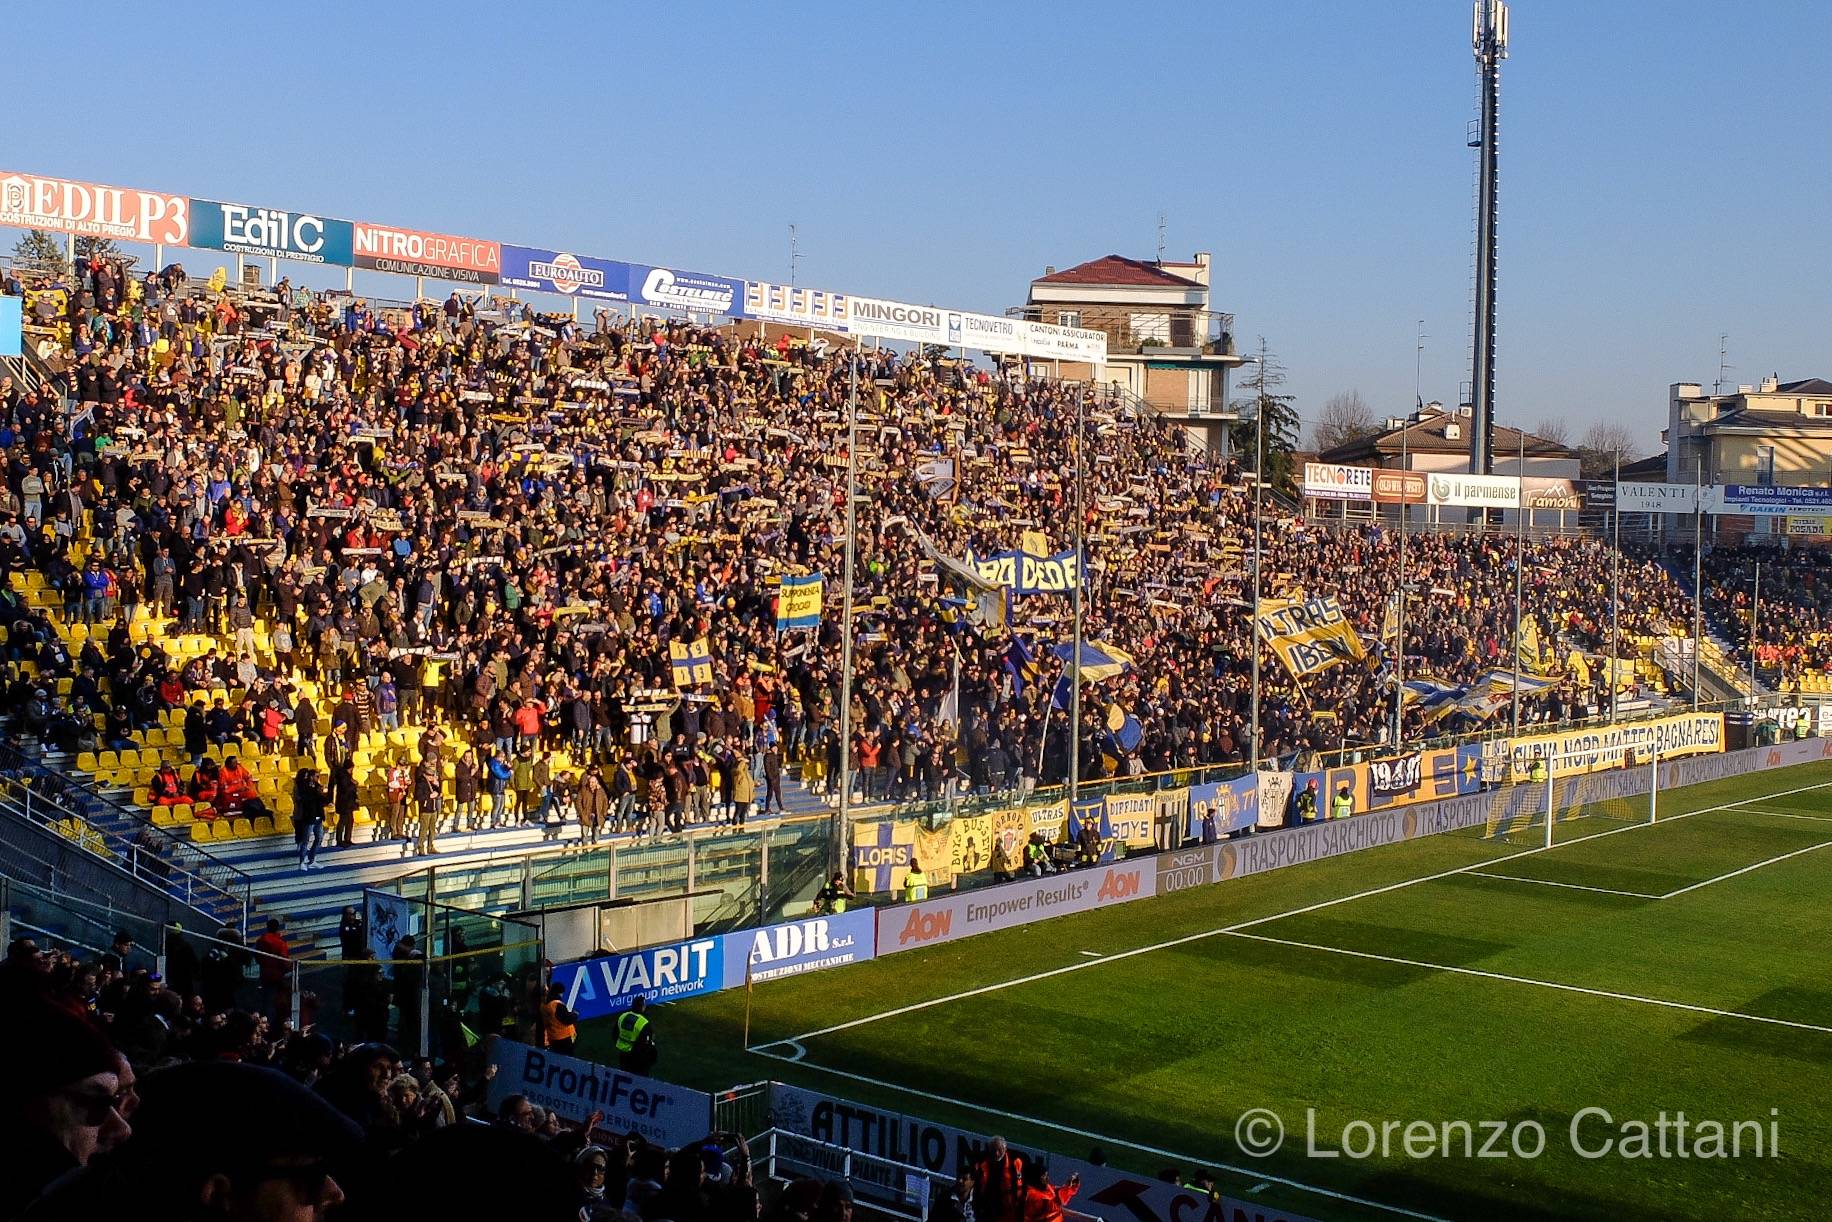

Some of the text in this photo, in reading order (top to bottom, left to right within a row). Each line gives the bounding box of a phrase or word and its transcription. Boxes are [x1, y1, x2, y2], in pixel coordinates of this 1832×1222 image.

[1, 211, 137, 239] COSTRUZIONI DI ALTO PREGIO
[220, 203, 325, 254] Edil C
[223, 242, 325, 264] COSTRUZIONI DI PRESTIGIO
[375, 257, 481, 283] COMUNICAZIONE VISIVA
[534, 264, 601, 285] EUROAUTO
[853, 301, 941, 327] MINGORI
[965, 317, 1014, 336] TECNOVETRO
[1057, 340, 1079, 350] PARMA
[1454, 482, 1517, 502] il parmense
[1621, 486, 1686, 499] VALENTI
[1738, 485, 1774, 496] Renato
[1776, 486, 1814, 497] Monica
[1751, 496, 1787, 505] Tecnologici
[1563, 736, 1600, 768] NORD
[1031, 806, 1064, 823] ULTRAS
[1110, 798, 1154, 816] DIFFIDATI
[1421, 799, 1486, 836] TRASPORTI
[1240, 812, 1396, 874] TRASPORTI SARCHIOTO
[858, 846, 907, 867] LORIS
[1171, 850, 1206, 868] NGM
[1165, 867, 1205, 892] 00:00
[966, 893, 1033, 924] Empower
[751, 918, 831, 965] ADR
[600, 940, 715, 997] VARIT
[750, 952, 854, 982] OSTRUZIONI MECCANICHE
[660, 978, 705, 998] network
[523, 1050, 665, 1119] BroniFer
[811, 1100, 947, 1171] ATTILIO
